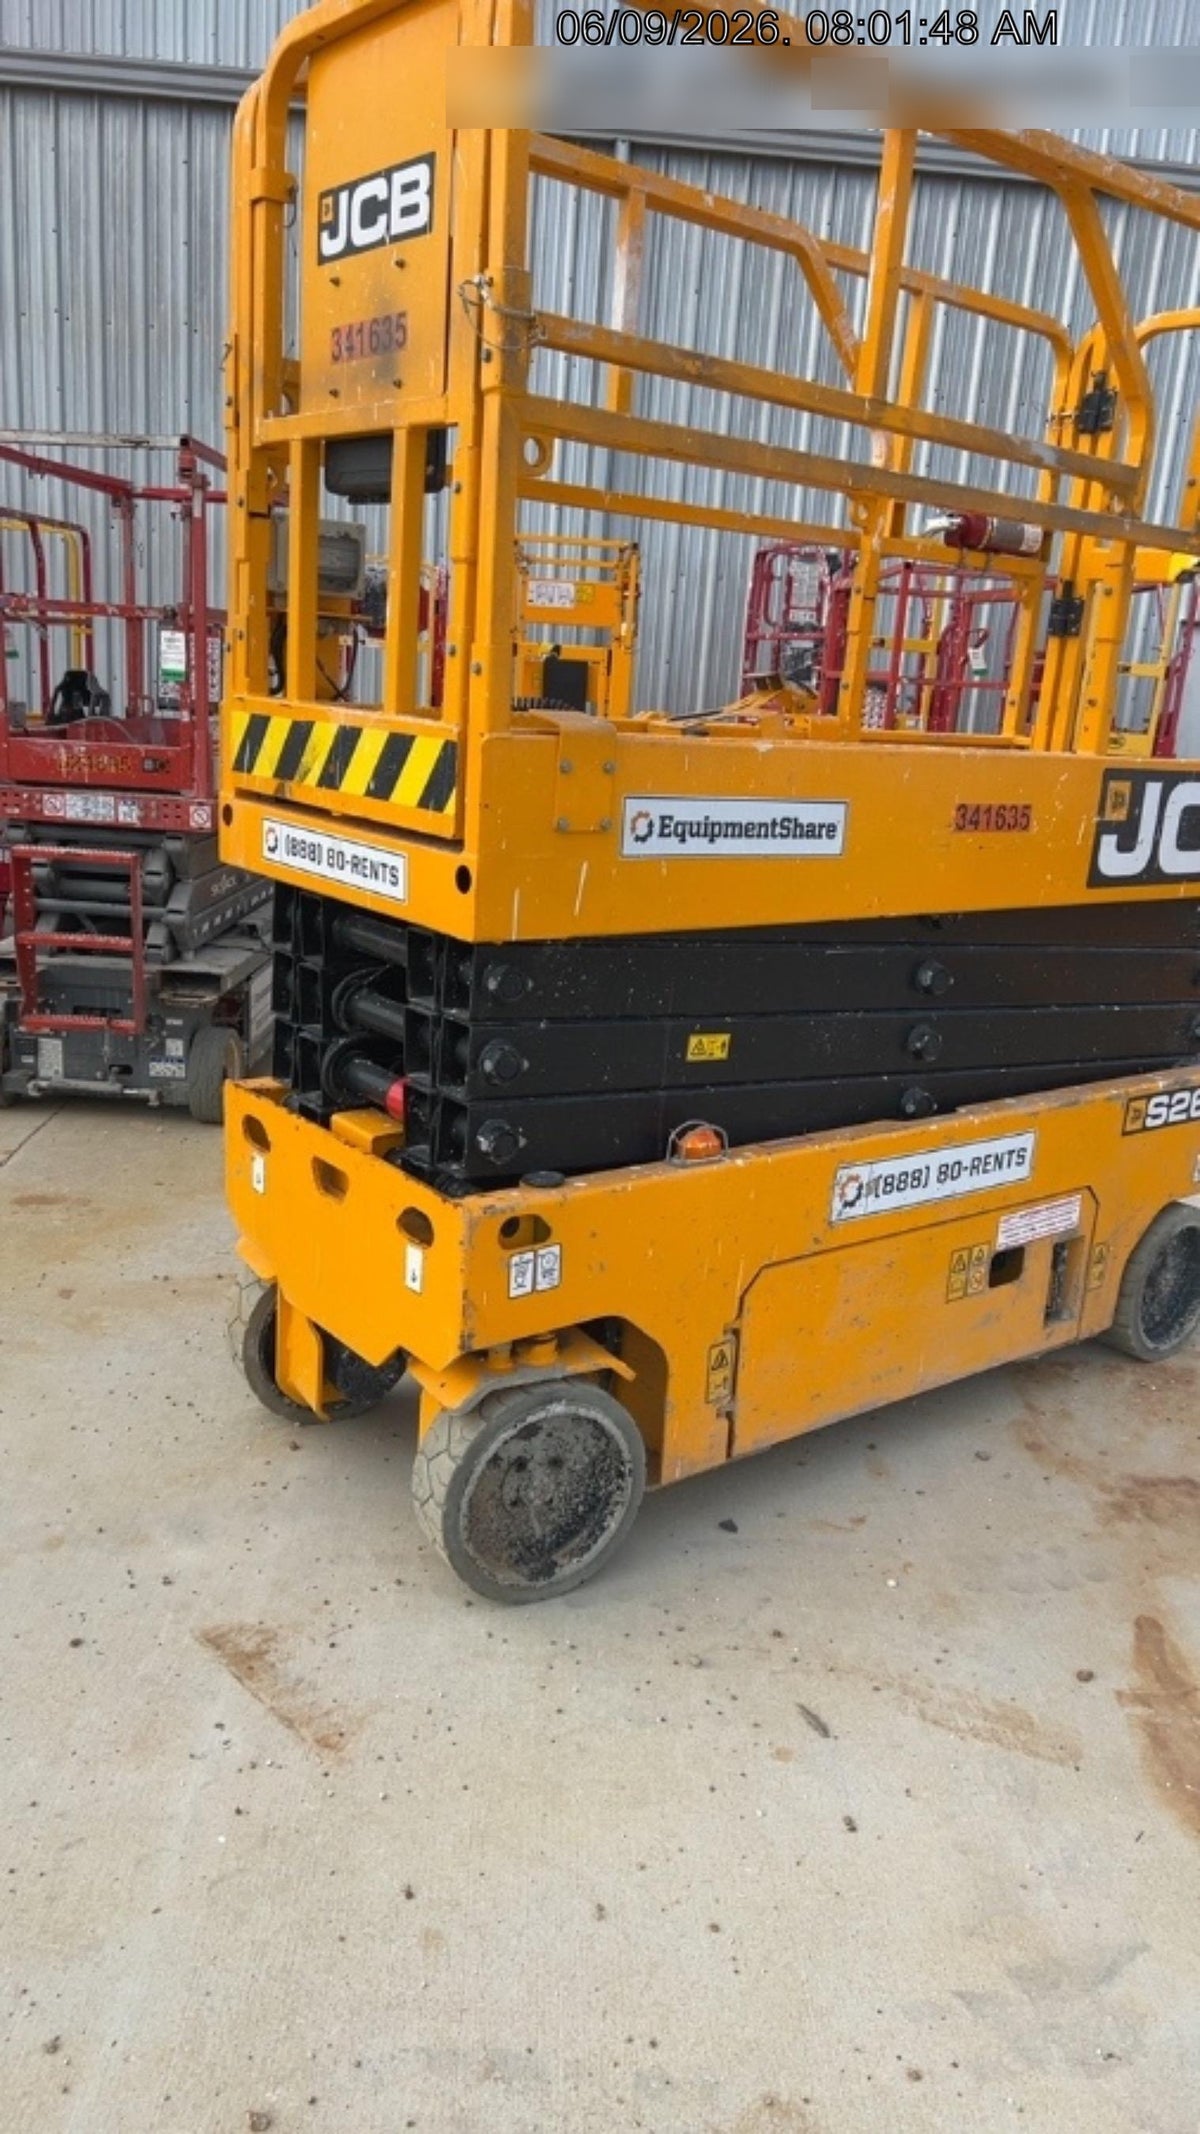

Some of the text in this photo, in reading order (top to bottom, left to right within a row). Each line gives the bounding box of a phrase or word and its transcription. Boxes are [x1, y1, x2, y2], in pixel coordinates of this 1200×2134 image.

[320, 162, 431, 257] JCB
[331, 311, 408, 362] 341635
[658, 815, 838, 844] EquipmentShare
[955, 803, 1031, 831] 341635
[284, 832, 399, 887] (888) 80-RENTS
[873, 1147, 1028, 1198] (888) 80-RENTS
